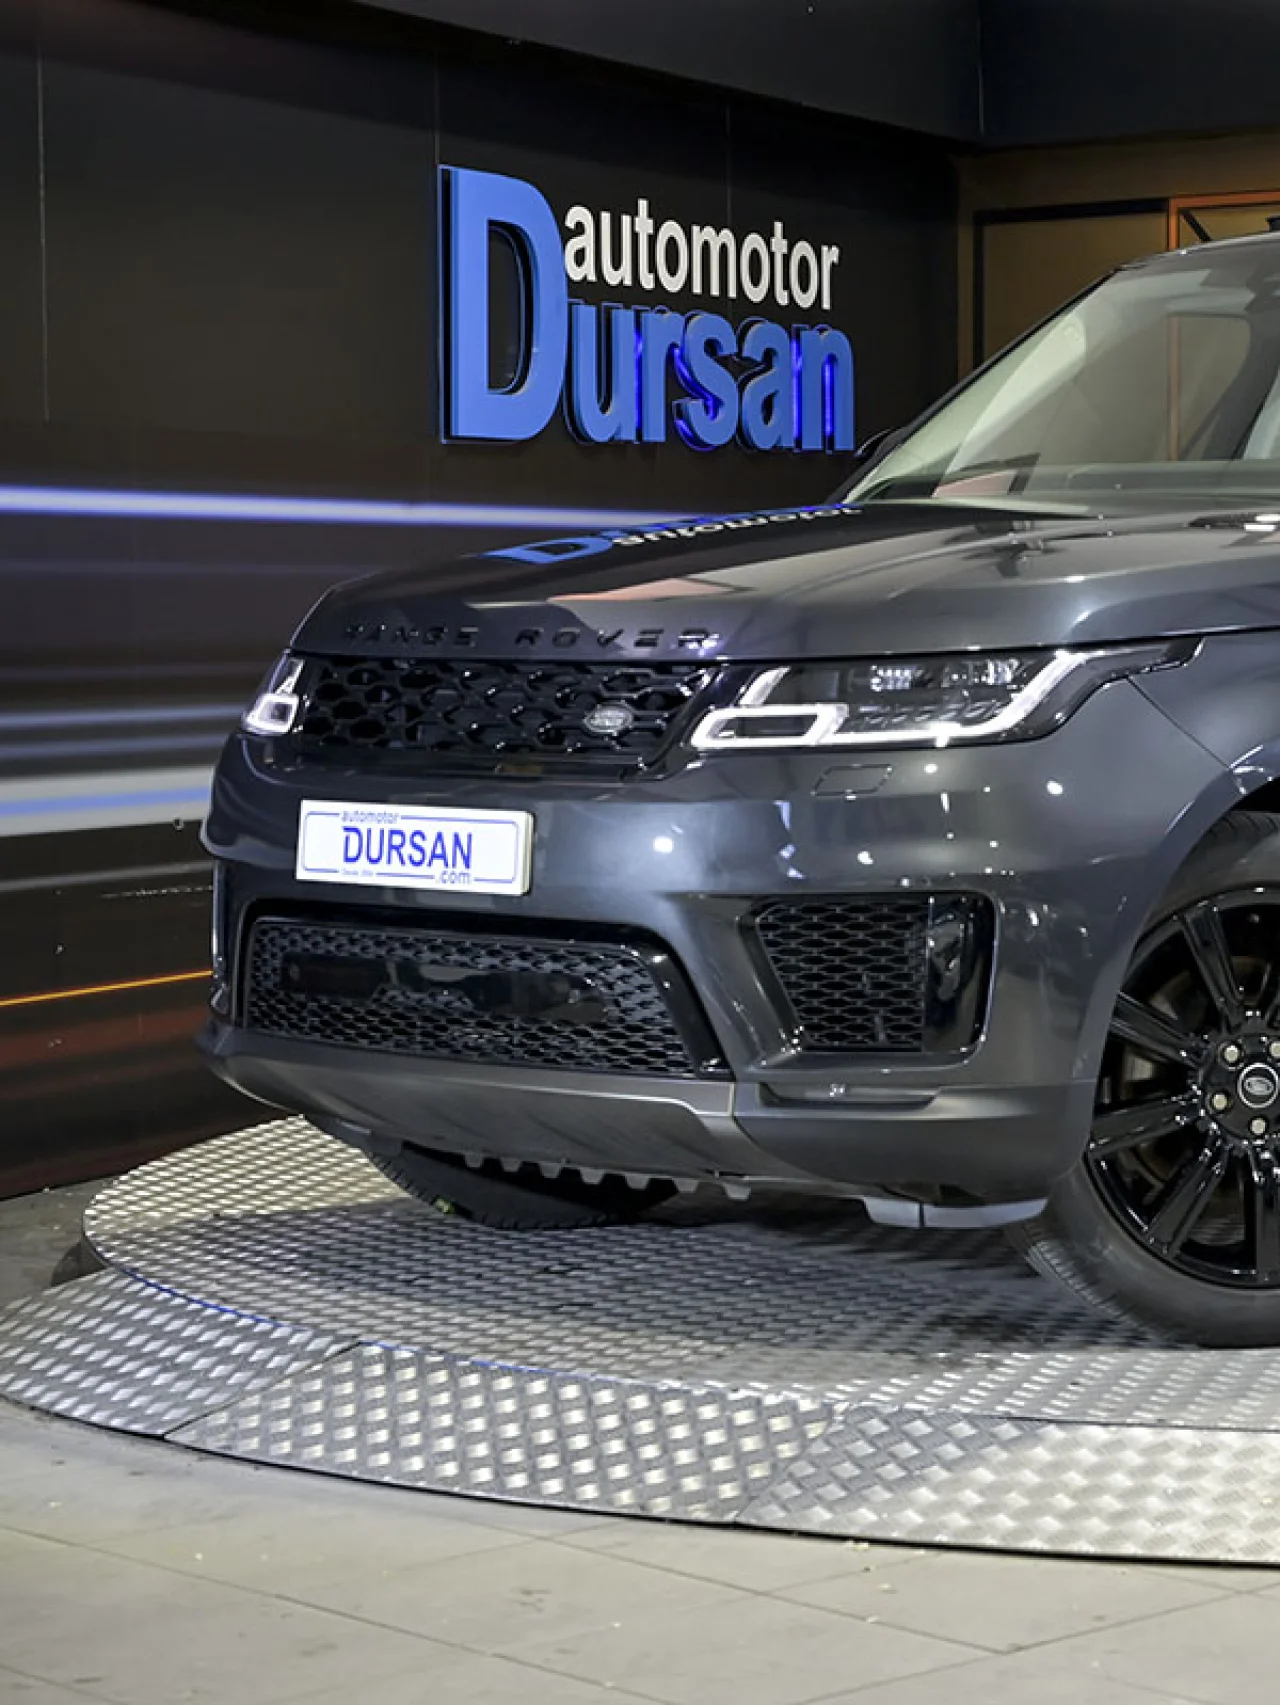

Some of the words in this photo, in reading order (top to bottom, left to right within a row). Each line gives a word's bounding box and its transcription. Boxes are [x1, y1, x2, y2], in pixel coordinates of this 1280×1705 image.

[564, 198, 840, 310] automotor
[438, 164, 855, 454] Dursan
[513, 626, 720, 649] ROVER
[342, 826, 473, 869] DURSAN
